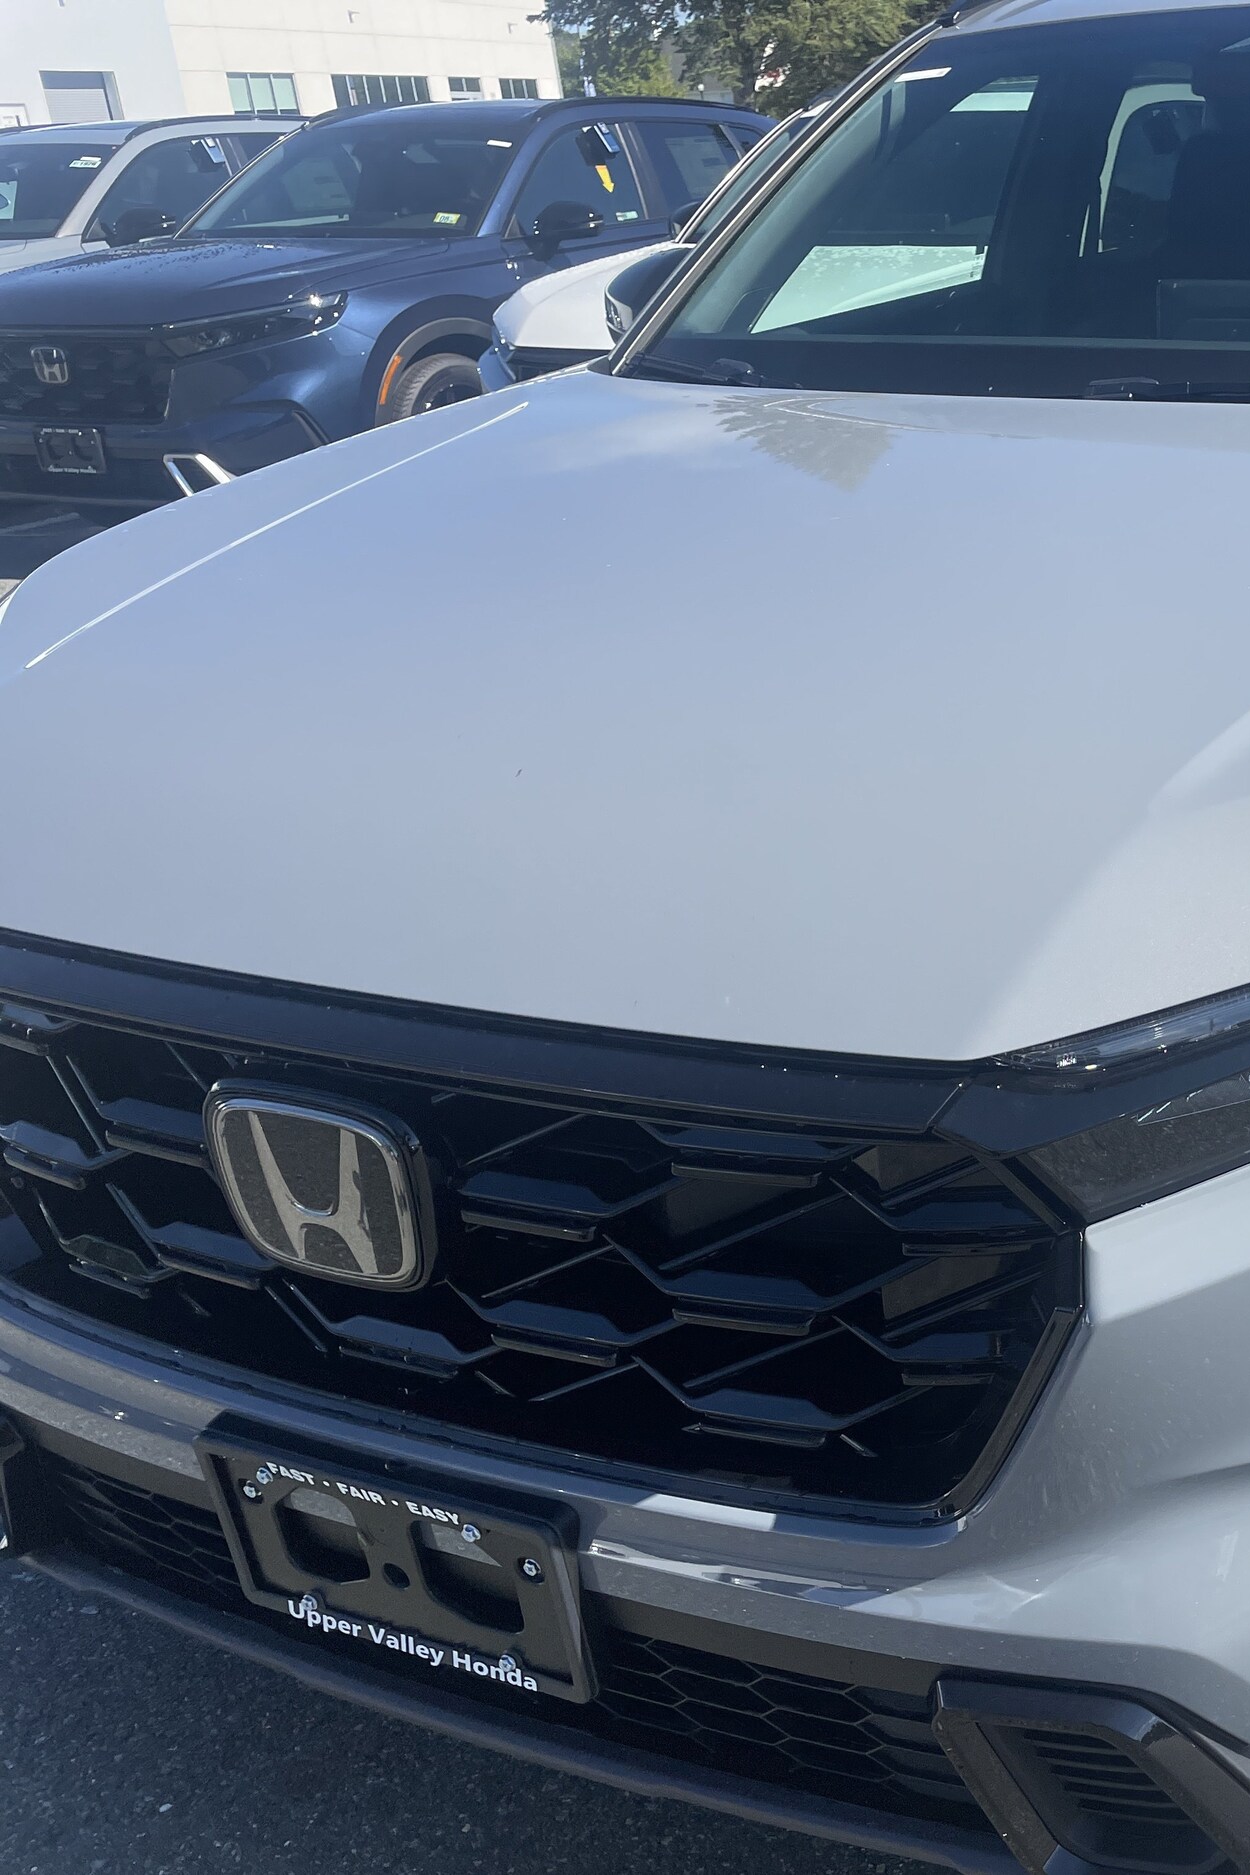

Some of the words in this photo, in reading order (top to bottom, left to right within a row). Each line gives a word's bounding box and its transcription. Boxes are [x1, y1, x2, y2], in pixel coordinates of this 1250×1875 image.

[265, 1461, 315, 1486] FAST
[336, 1482, 386, 1506] FAIR
[405, 1500, 459, 1525] EASY
[287, 1599, 362, 1637] Upper
[367, 1624, 444, 1667] Valley
[452, 1650, 538, 1692] Honda
